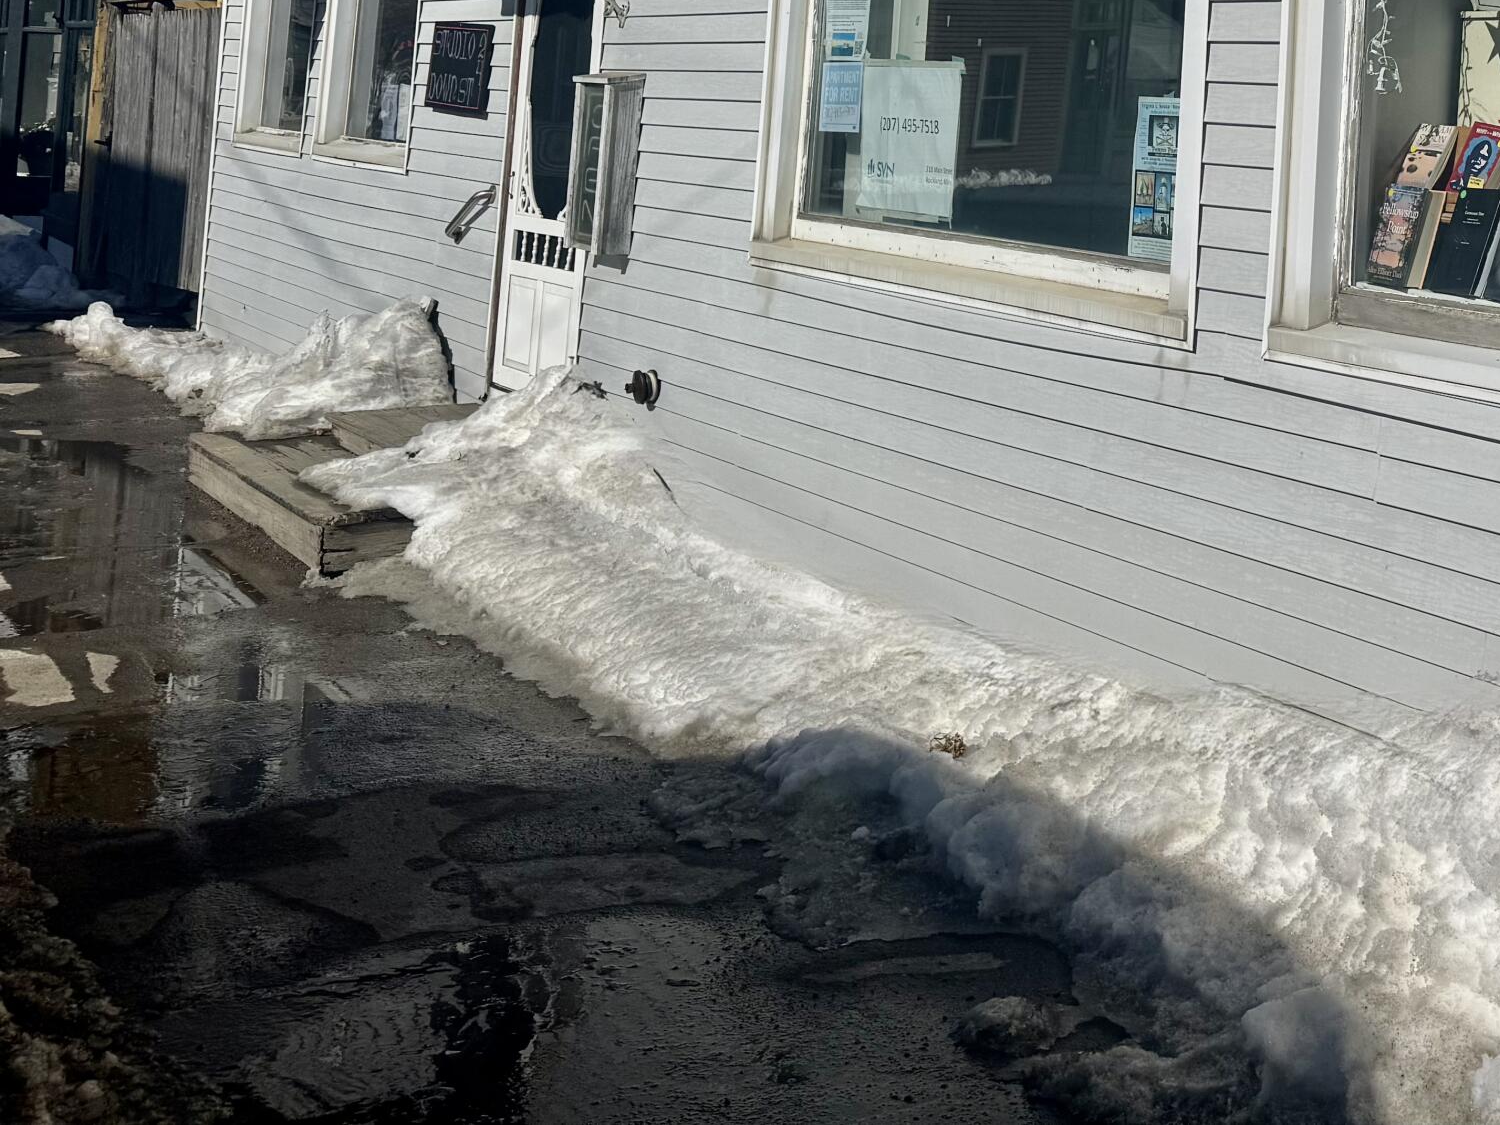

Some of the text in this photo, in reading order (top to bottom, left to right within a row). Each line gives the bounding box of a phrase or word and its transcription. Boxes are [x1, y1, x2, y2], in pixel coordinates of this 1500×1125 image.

[433, 29, 476, 60] STUDIO
[825, 68, 860, 84] APARTMENT
[824, 86, 859, 102] FOR RENT
[880, 115, 940, 135] (207) 495-7518
[877, 161, 895, 179] SVN
[1382, 202, 1420, 220] Fellowship
[1387, 220, 1407, 235] Point
